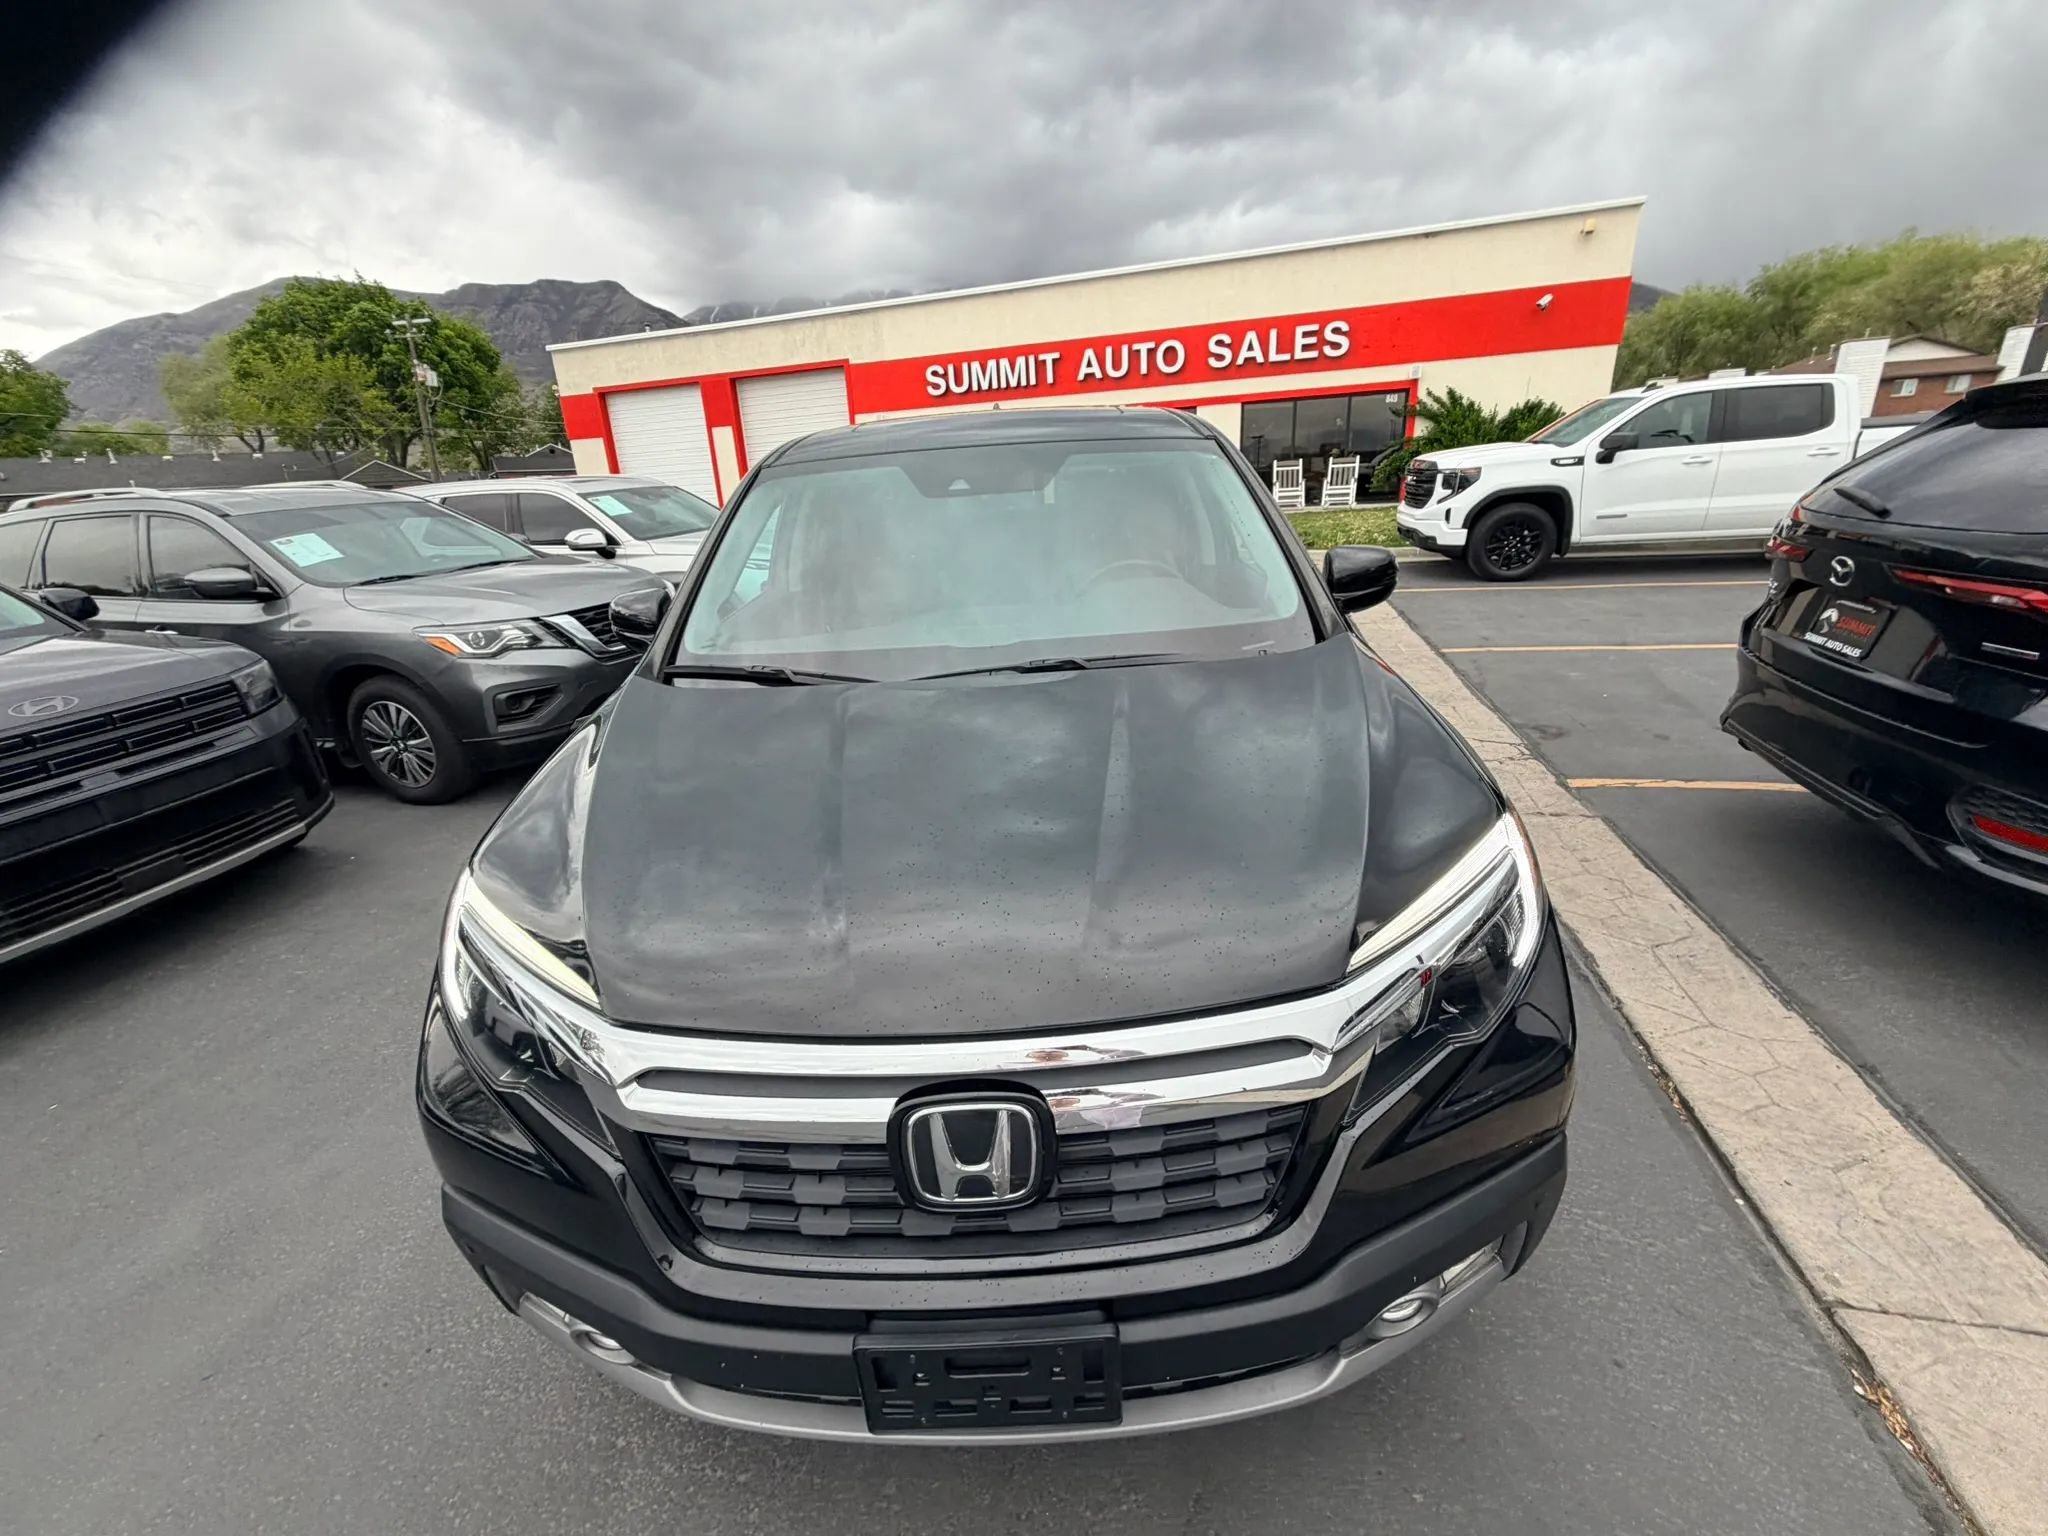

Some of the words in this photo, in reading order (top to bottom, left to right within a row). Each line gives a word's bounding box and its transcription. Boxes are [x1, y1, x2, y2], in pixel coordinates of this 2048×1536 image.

[925, 351, 1061, 397] SUMMIT
[1077, 339, 1186, 382] AUTO
[1207, 320, 1351, 368] SALES
[1836, 616, 1877, 635] SUMMIT
[1824, 639, 1844, 652] AUTO
[1841, 645, 1862, 657] SALES
